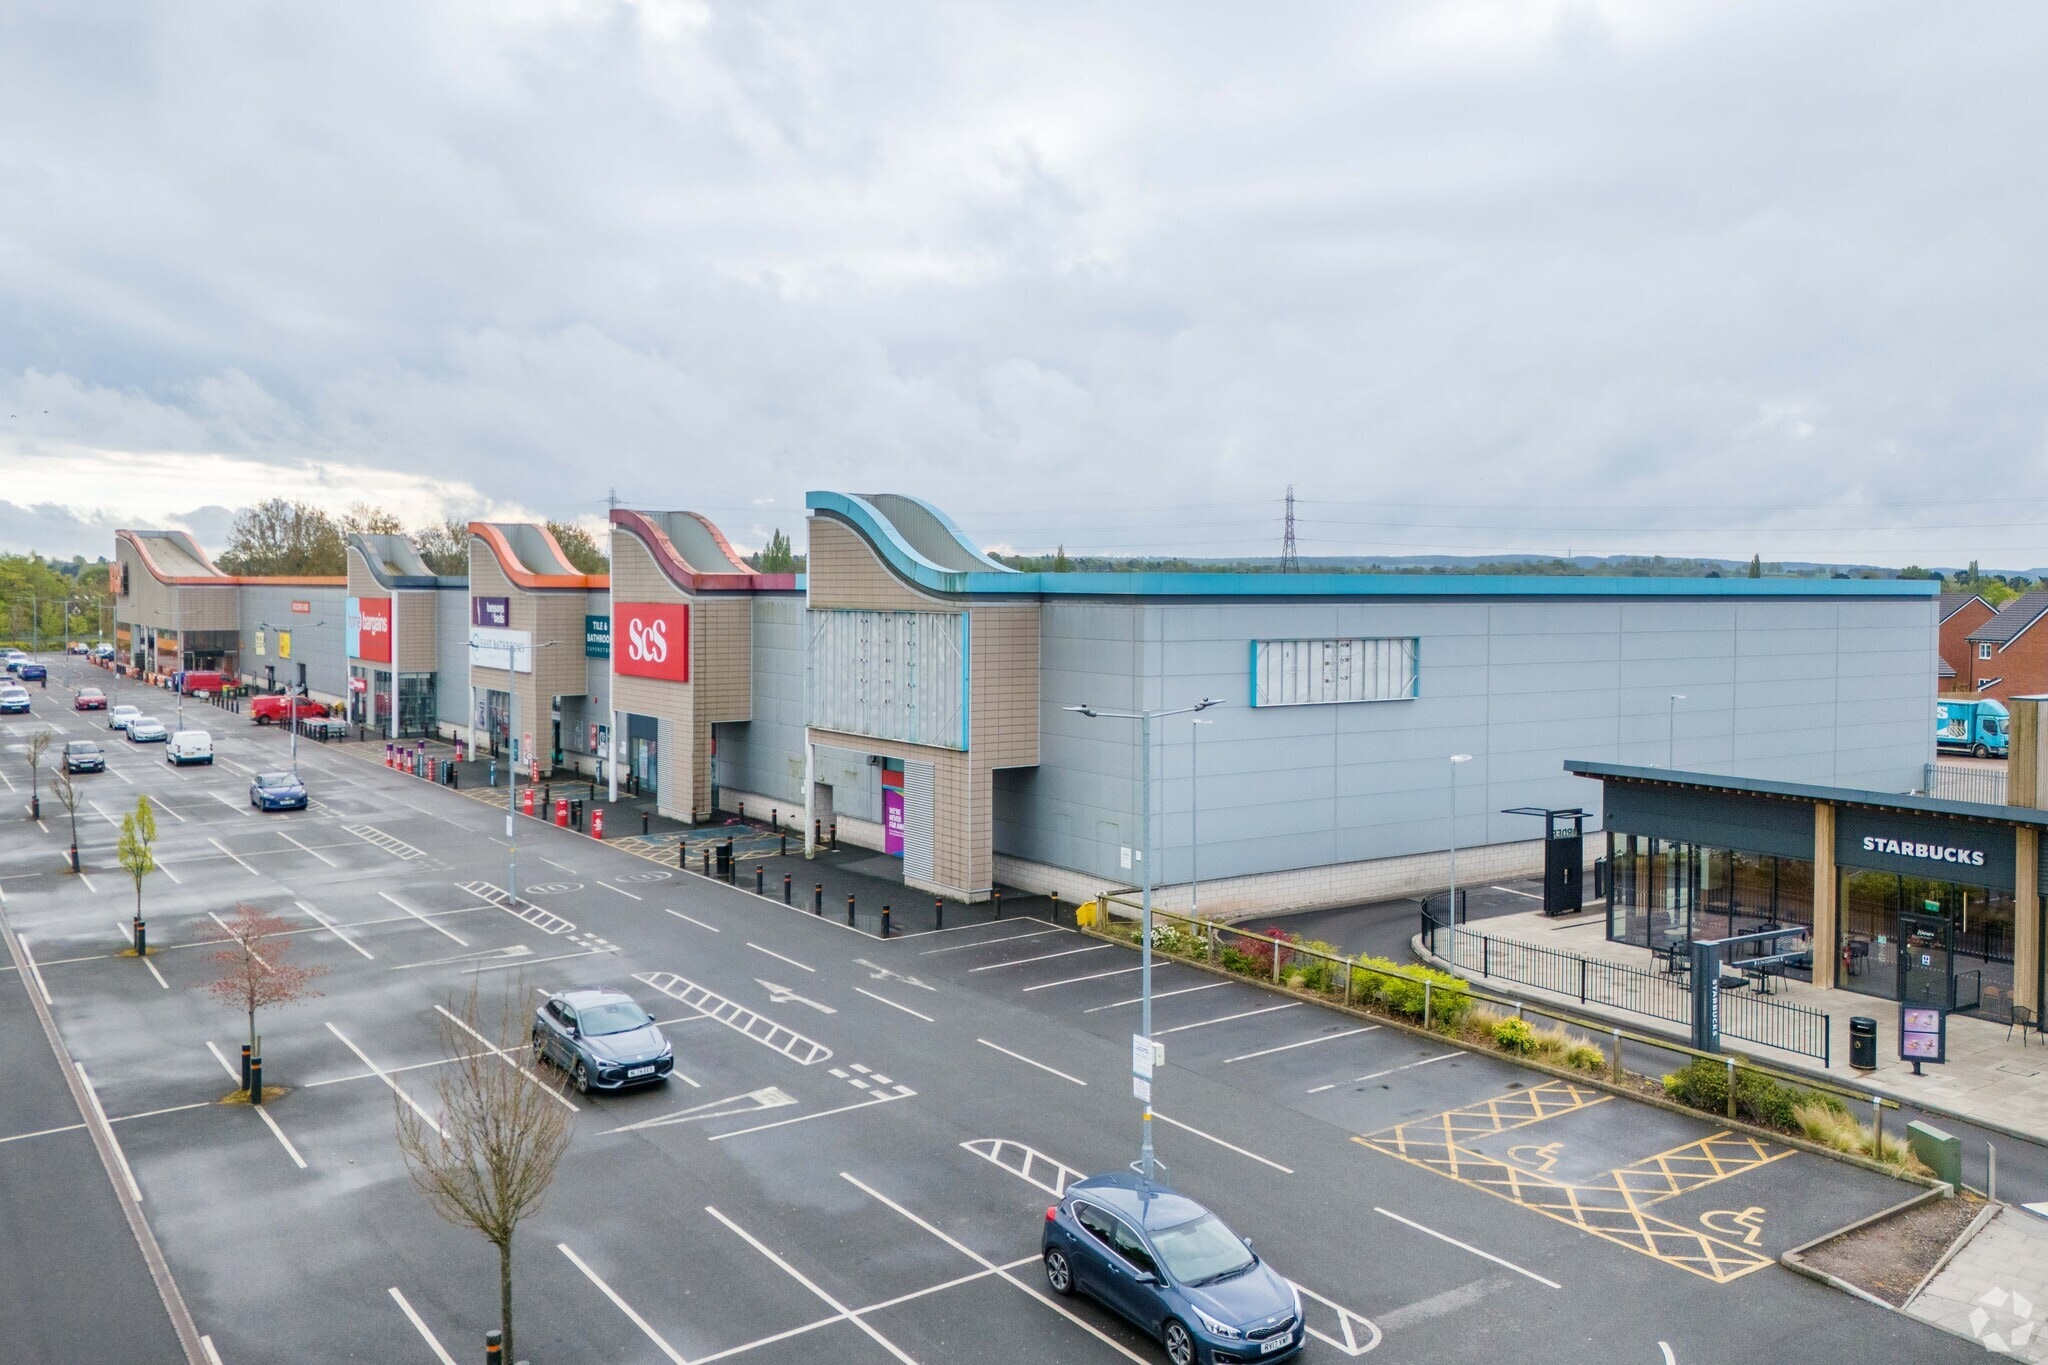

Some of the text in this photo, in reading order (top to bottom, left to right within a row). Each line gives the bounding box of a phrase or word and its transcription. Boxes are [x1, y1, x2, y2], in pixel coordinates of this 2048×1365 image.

[362, 611, 387, 636] bargains
[592, 621, 608, 630] TILE &
[628, 618, 667, 662] ScS
[1863, 836, 1985, 866] STARBUCKS
